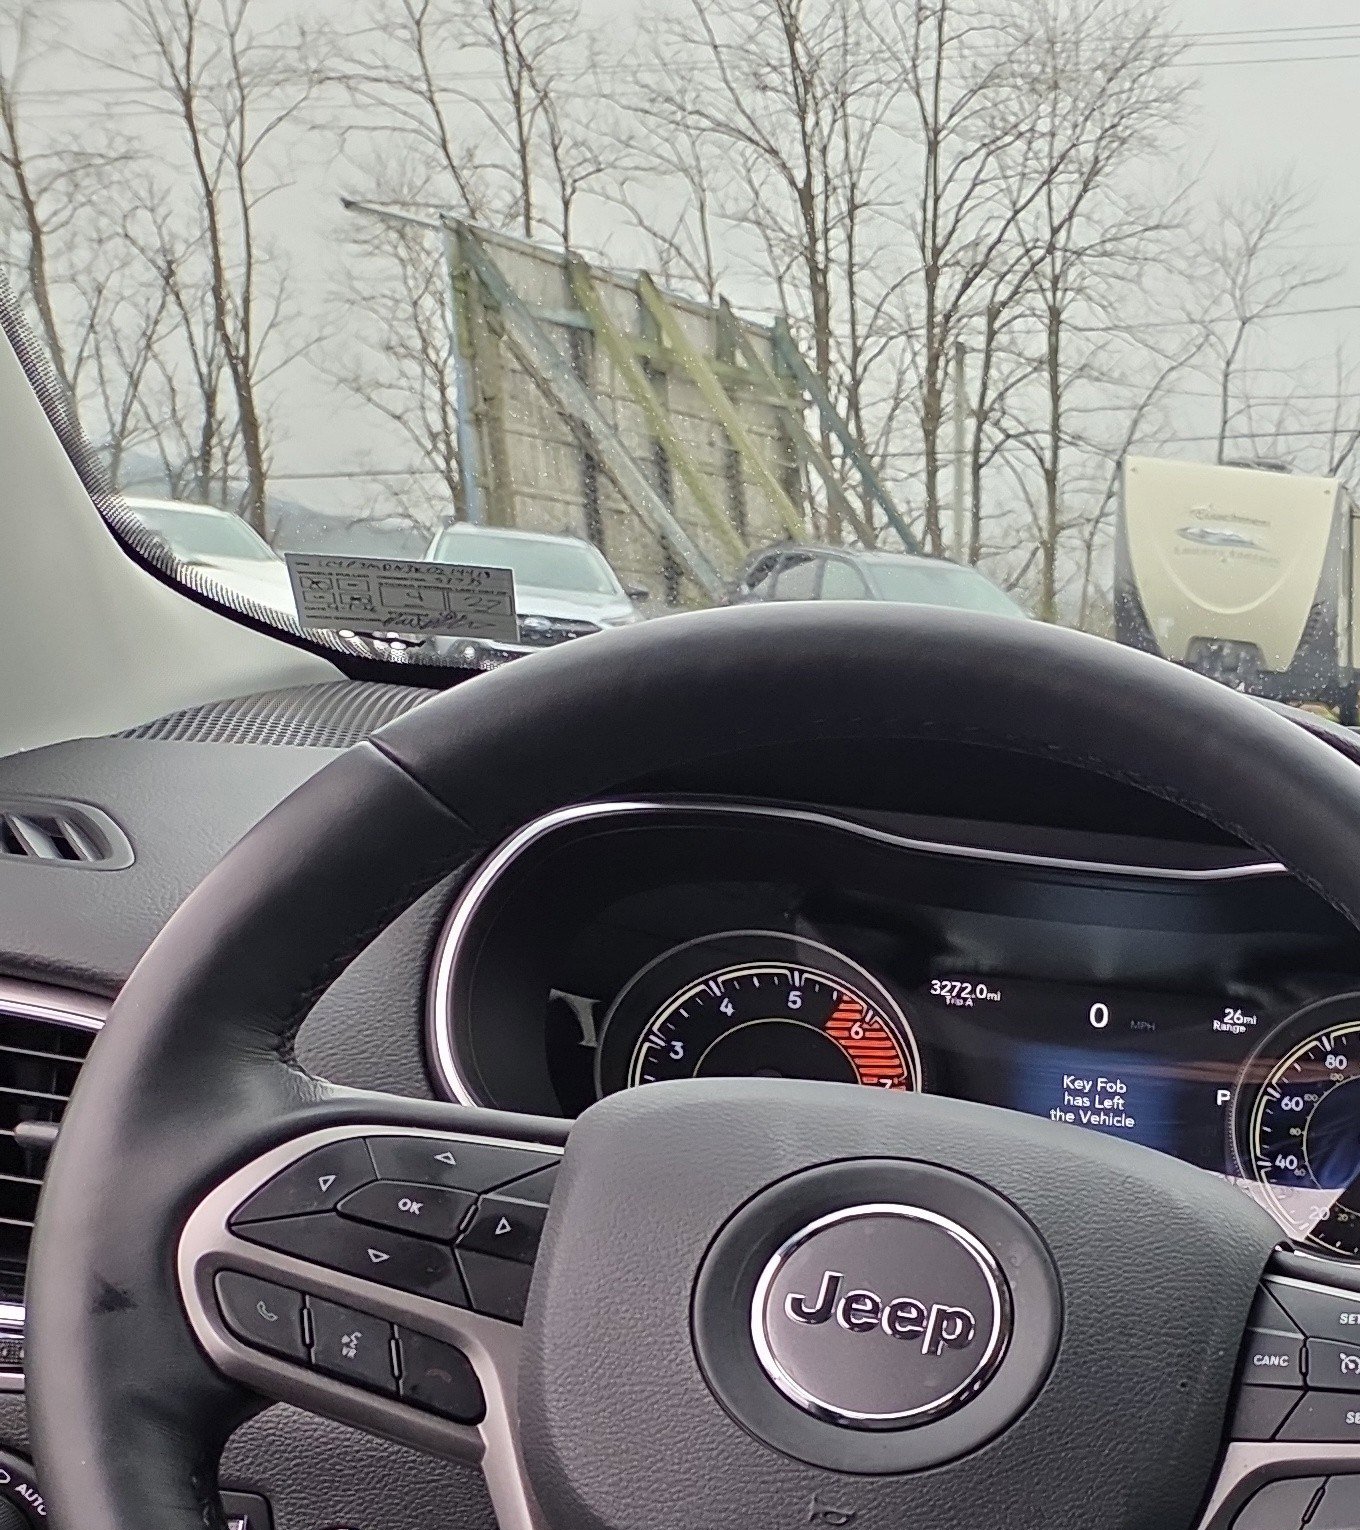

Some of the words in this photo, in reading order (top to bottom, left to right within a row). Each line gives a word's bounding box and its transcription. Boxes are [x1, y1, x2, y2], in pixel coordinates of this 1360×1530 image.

[719, 998, 736, 1017] 4
[788, 990, 802, 1009] 5
[1089, 1003, 1109, 1028] 0
[1131, 1020, 1156, 1031] MPH
[851, 1022, 864, 1039] 6
[1213, 1020, 1246, 1033] Range
[669, 1041, 684, 1059] 3
[1325, 1052, 1348, 1070] 80
[1063, 1075, 1090, 1093] Key
[1097, 1077, 1127, 1094] Fob
[1064, 1092, 1090, 1107] has
[1095, 1095, 1124, 1110] Left
[1216, 1090, 1231, 1106] P
[1281, 1096, 1304, 1112] 60
[1050, 1108, 1075, 1123] the
[1079, 1109, 1135, 1128] Vehicle
[1275, 1154, 1298, 1171] 40
[396, 1198, 422, 1216] OK
[784, 1269, 976, 1356] Jeep
[1253, 1354, 1289, 1367] CANC
